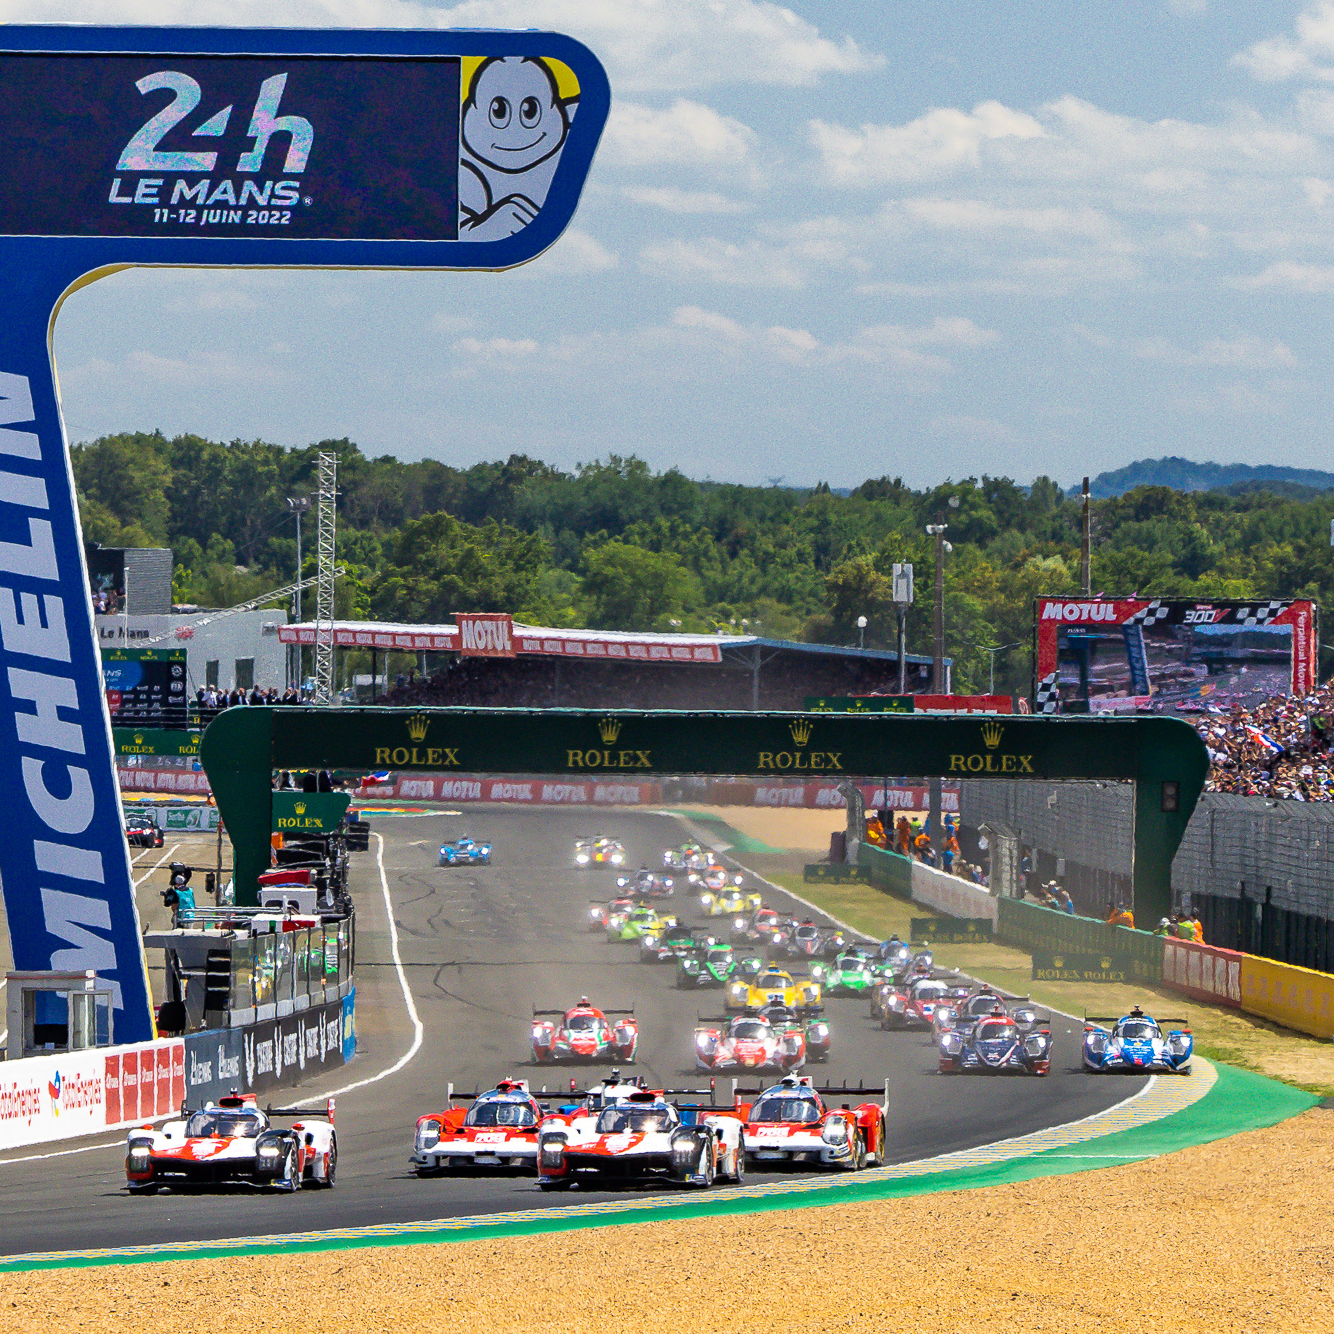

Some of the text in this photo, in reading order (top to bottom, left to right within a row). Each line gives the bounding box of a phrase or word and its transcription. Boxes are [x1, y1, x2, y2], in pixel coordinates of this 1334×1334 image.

[116, 71, 315, 173] 24h
[108, 178, 301, 206] LE MANS
[153, 209, 292, 227] 11-12 JUIN 2022
[1042, 602, 1118, 621] MOTUL
[1182, 608, 1231, 624] 300V
[461, 620, 512, 651] MOTUL
[121, 745, 200, 754] ROLEX ROL
[375, 747, 1035, 773] ROLEX ROLEX ROLEX ROLEX
[441, 781, 482, 799] MOTUL
[490, 782, 533, 800] MOTUL
[871, 789, 914, 808] MOTUL
[277, 817, 324, 828] ROLEX
